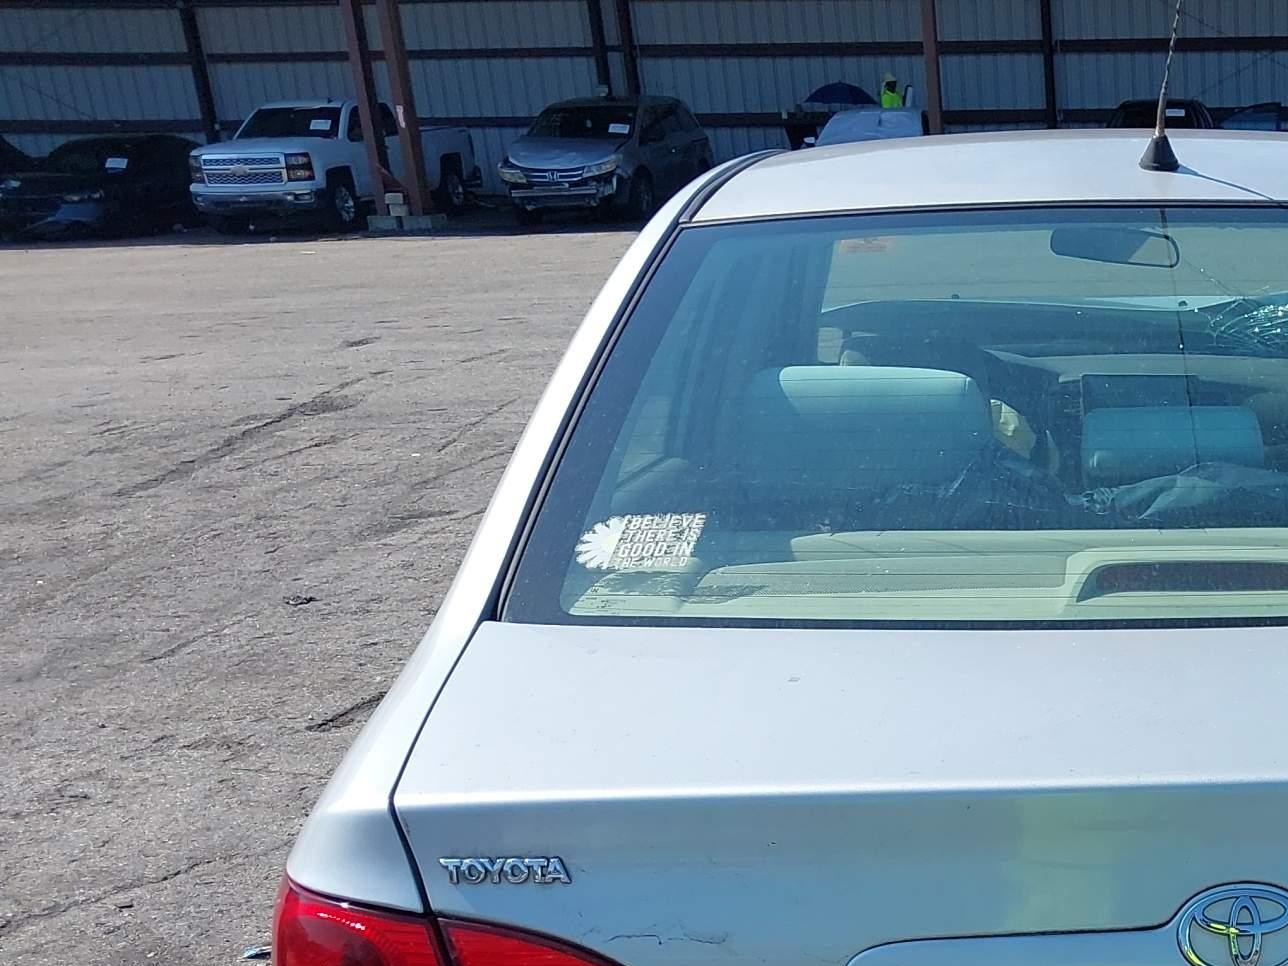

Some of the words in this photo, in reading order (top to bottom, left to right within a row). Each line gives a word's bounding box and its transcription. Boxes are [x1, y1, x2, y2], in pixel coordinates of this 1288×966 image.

[629, 513, 706, 530] BELIEVE
[624, 528, 678, 542] THERE
[619, 543, 667, 557] GOOD
[673, 542, 695, 556] IN
[439, 856, 572, 885] TOYOTA
